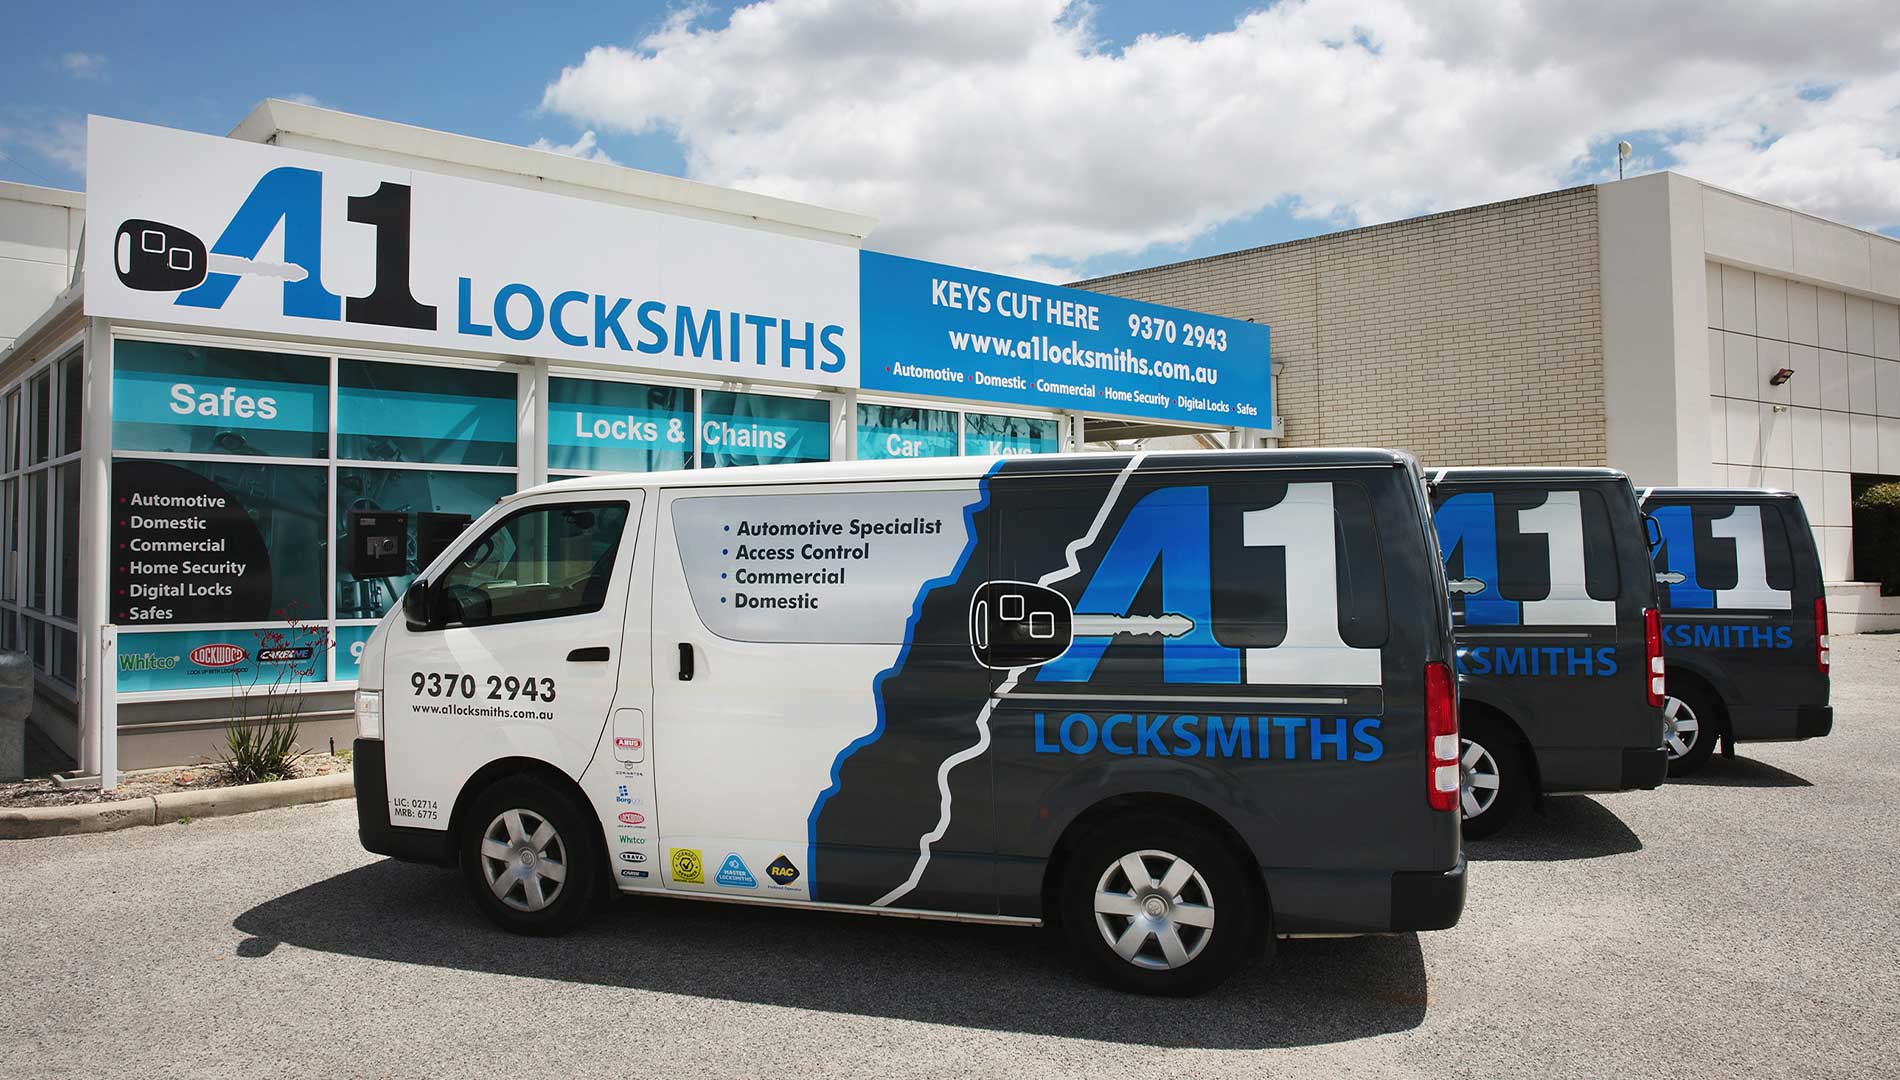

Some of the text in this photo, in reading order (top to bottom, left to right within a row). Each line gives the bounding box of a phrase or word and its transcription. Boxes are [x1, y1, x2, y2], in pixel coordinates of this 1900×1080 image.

[173, 166, 437, 330] A1
[932, 278, 1227, 352] KEYS CUT HERE 9370 2943
[458, 276, 846, 373] LOCKSMITHS
[949, 330, 1218, 385] www.a1locksmiths.com.au
[893, 361, 1257, 416] Automotive Domestic Commercial Home Security Digital Locks Safes
[170, 384, 277, 420] Safes
[576, 412, 786, 449] Locks & Chains
[886, 434, 922, 457] Car
[130, 493, 225, 508] Automotive
[130, 516, 206, 530] Domestic
[736, 518, 942, 539] Automotive Specialist
[130, 538, 225, 552] Commercial
[736, 543, 869, 560] Access Control
[130, 560, 246, 576] Home Security
[735, 568, 845, 584] Commercial
[130, 582, 232, 600] Digital Locks
[1033, 482, 1382, 685] A1
[735, 593, 819, 610] Domestic
[129, 606, 173, 620] Safes
[119, 653, 176, 671] Whitco
[411, 671, 556, 703] 9370 2943
[412, 704, 553, 720] www.a1locksmiths.com.au
[1034, 711, 1384, 761] LOCKSMITHS
[394, 798, 438, 810] LIC: 02714
[394, 808, 438, 820] MRB: 6775
[771, 866, 794, 877] RAC
